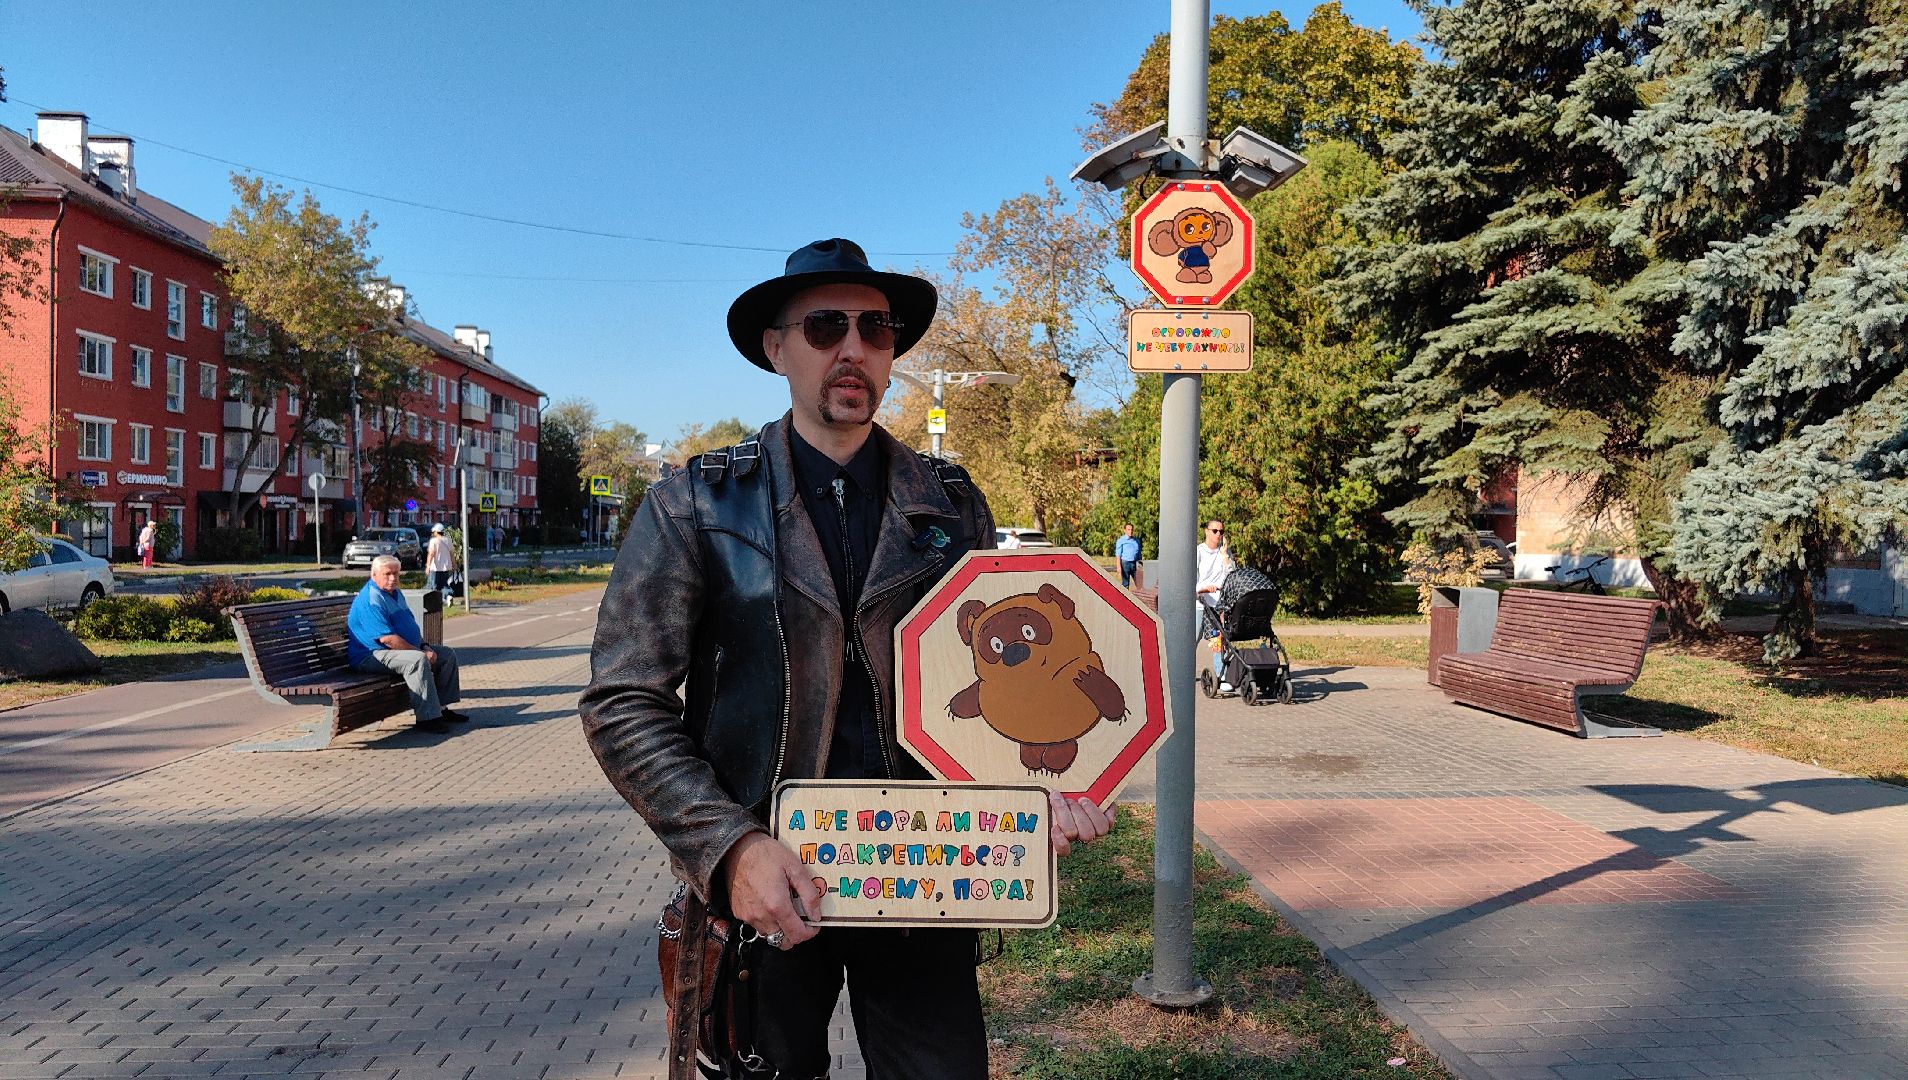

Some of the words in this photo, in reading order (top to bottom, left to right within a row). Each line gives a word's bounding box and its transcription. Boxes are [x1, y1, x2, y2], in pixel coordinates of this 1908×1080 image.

[1152, 328, 1231, 339] ОСТОРОЖНО
[1137, 342, 1152, 352] НЕ
[127, 474, 167, 484] ЕРМОЛИНО
[789, 810, 805, 831] А
[815, 810, 848, 831] НЕ
[857, 810, 927, 831] ПОРА
[936, 811, 970, 832] ЛИ
[978, 811, 1038, 833] НАМ
[799, 843, 1026, 866] ПОДКРЕПИТЬСЯ?
[794, 877, 943, 902] О-МОЕМУ,
[953, 878, 1034, 901] ПОРА!
